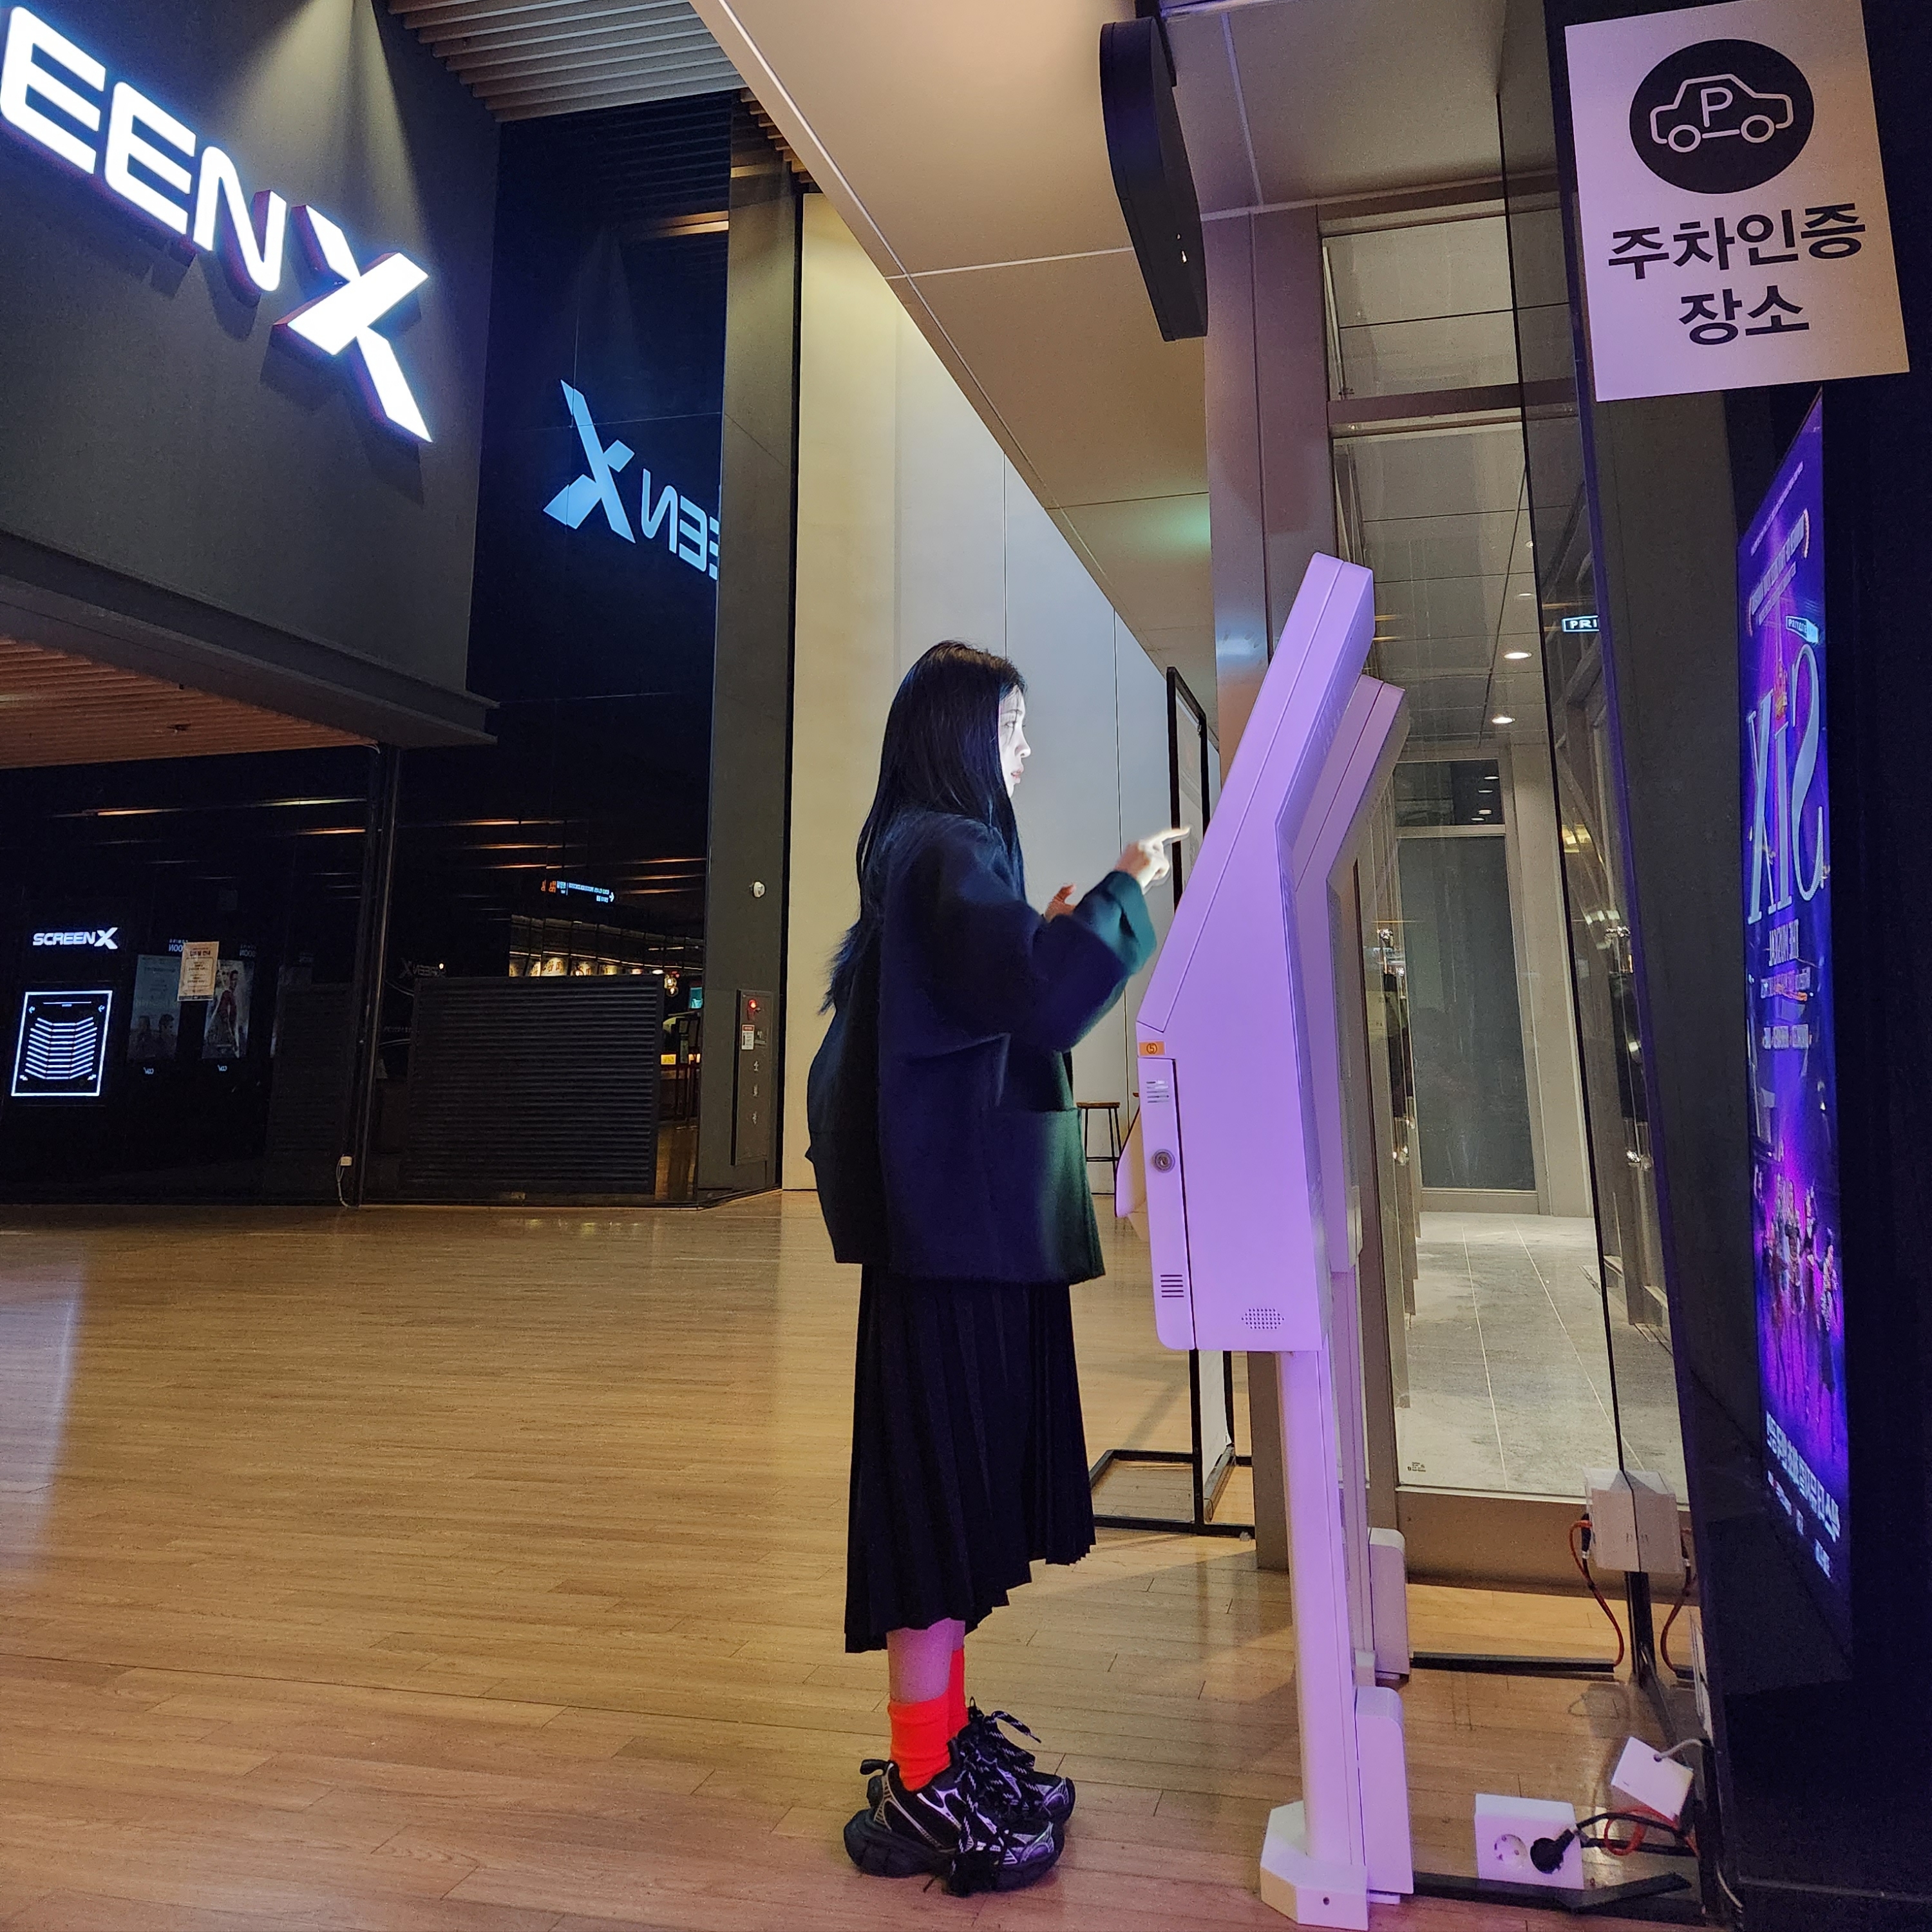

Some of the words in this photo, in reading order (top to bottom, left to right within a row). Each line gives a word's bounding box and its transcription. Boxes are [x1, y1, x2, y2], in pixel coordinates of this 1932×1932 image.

[1701, 87, 1733, 127] P
[0, 6, 433, 443] EENX
[1608, 203, 1866, 279] 주차인증
[1679, 285, 1810, 345] 장소
[33, 927, 118, 949] SCREENX
